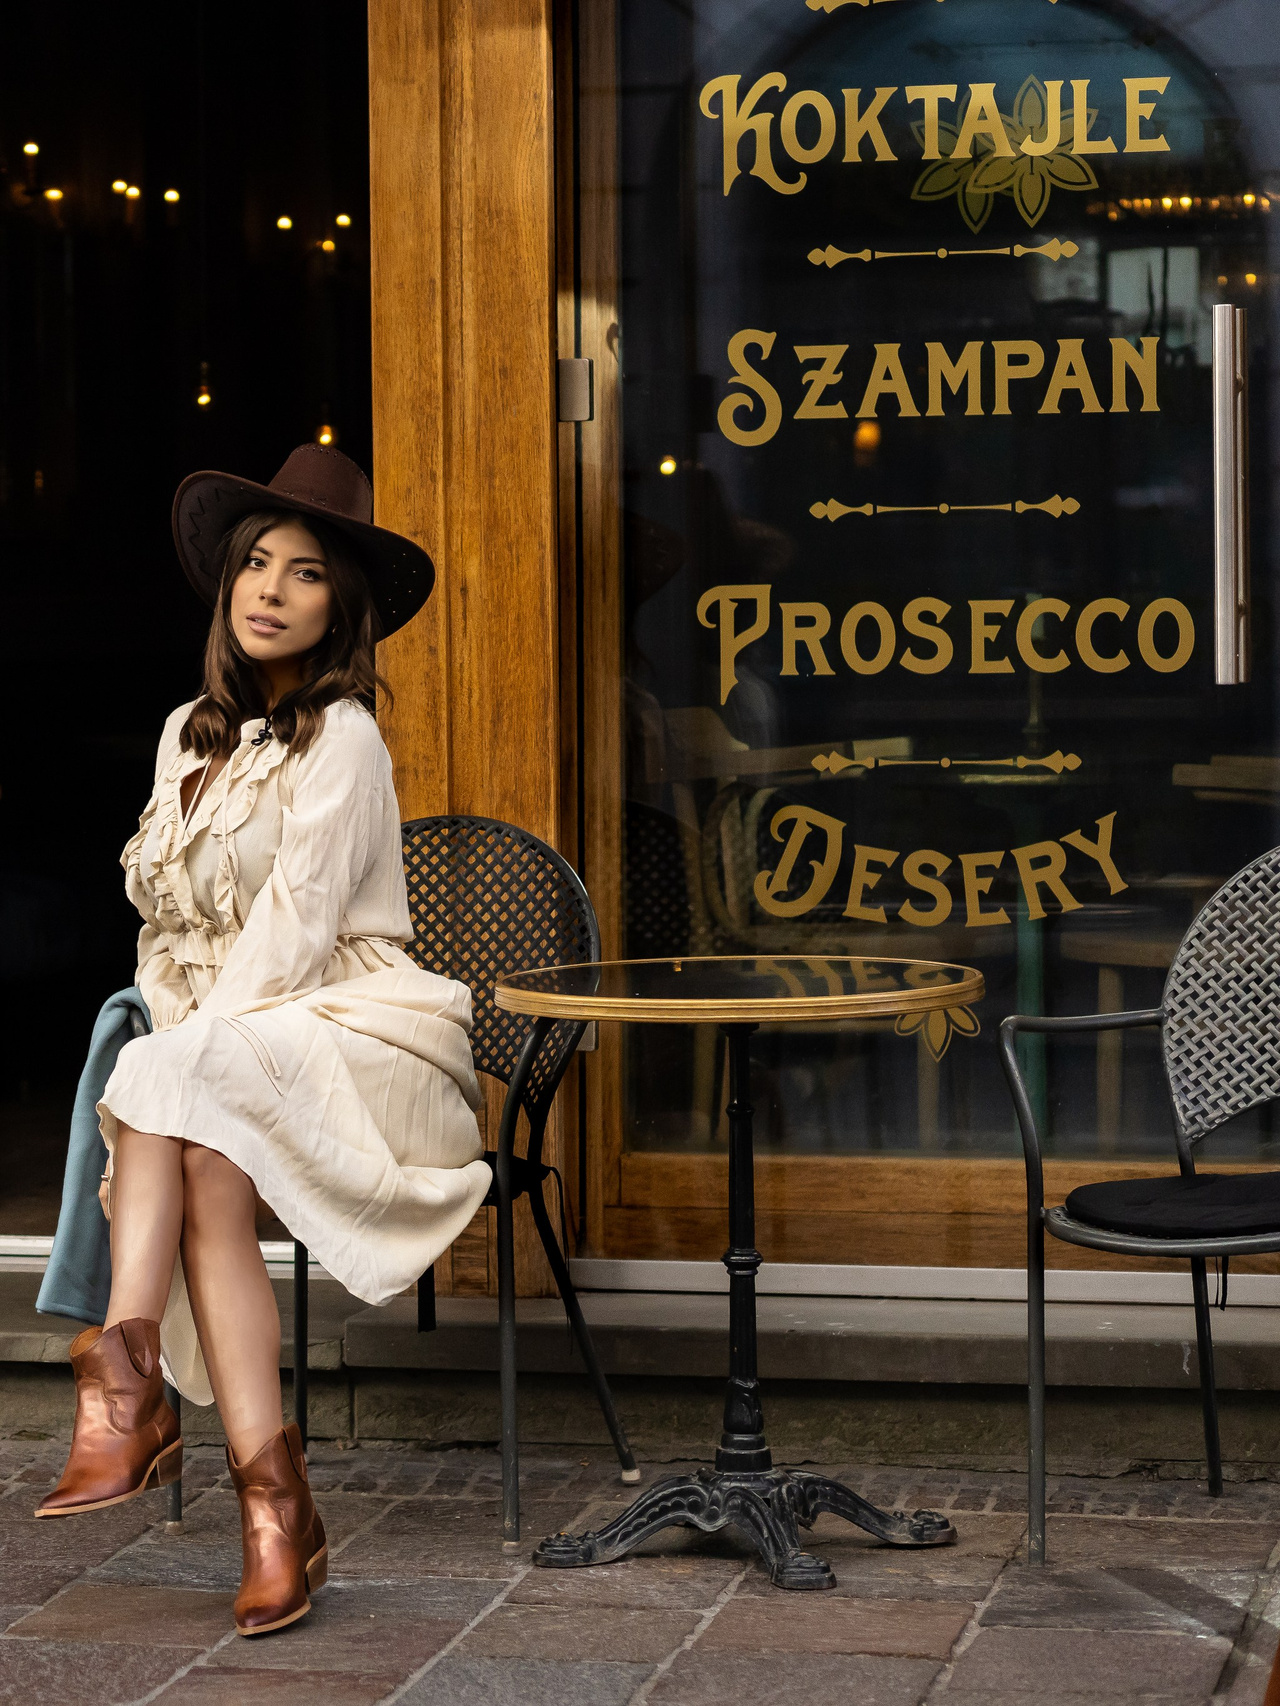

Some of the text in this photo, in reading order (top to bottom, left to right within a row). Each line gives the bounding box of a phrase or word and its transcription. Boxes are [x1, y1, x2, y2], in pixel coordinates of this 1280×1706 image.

[699, 72, 1172, 197] KOKTAJLE
[696, 584, 1195, 706] PROSECCO
[753, 804, 1129, 928] DESERY
